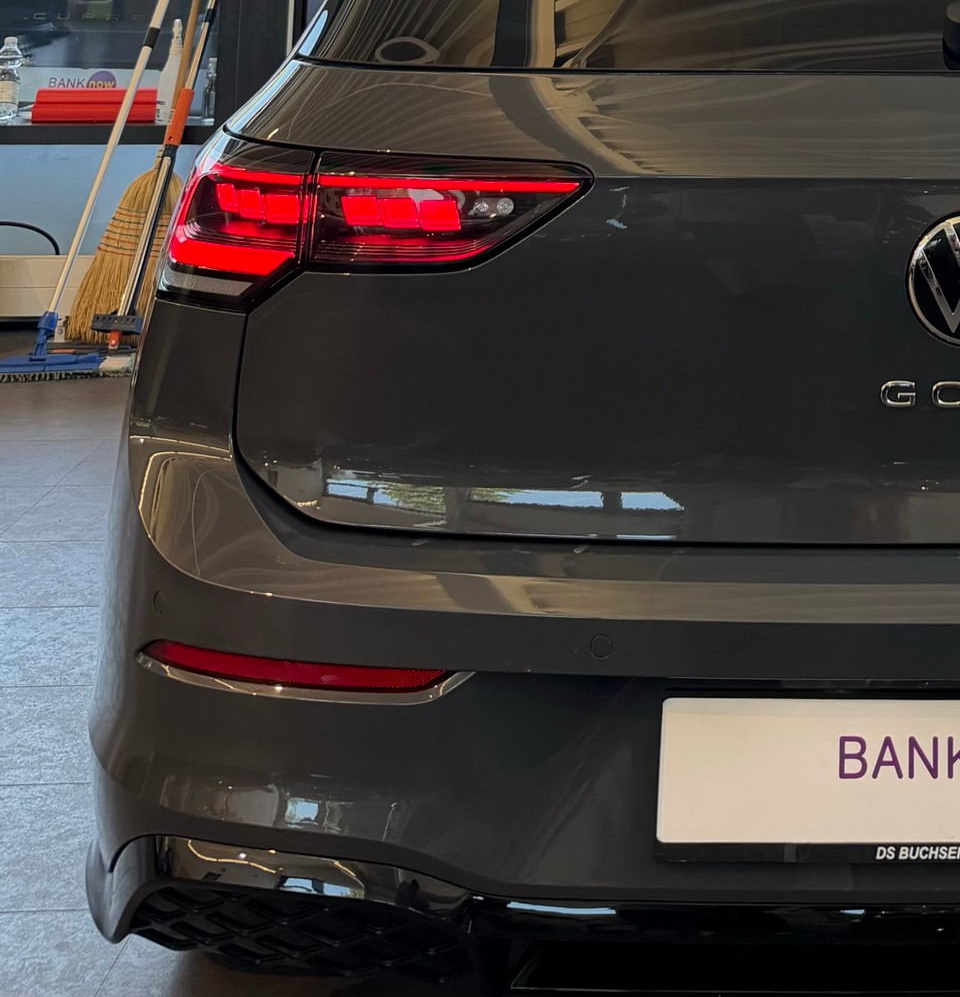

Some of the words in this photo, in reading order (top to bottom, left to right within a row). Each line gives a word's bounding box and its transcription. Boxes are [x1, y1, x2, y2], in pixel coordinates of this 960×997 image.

[48, 77, 86, 89] BANK
[87, 79, 116, 89] now
[875, 846, 896, 860] DS
